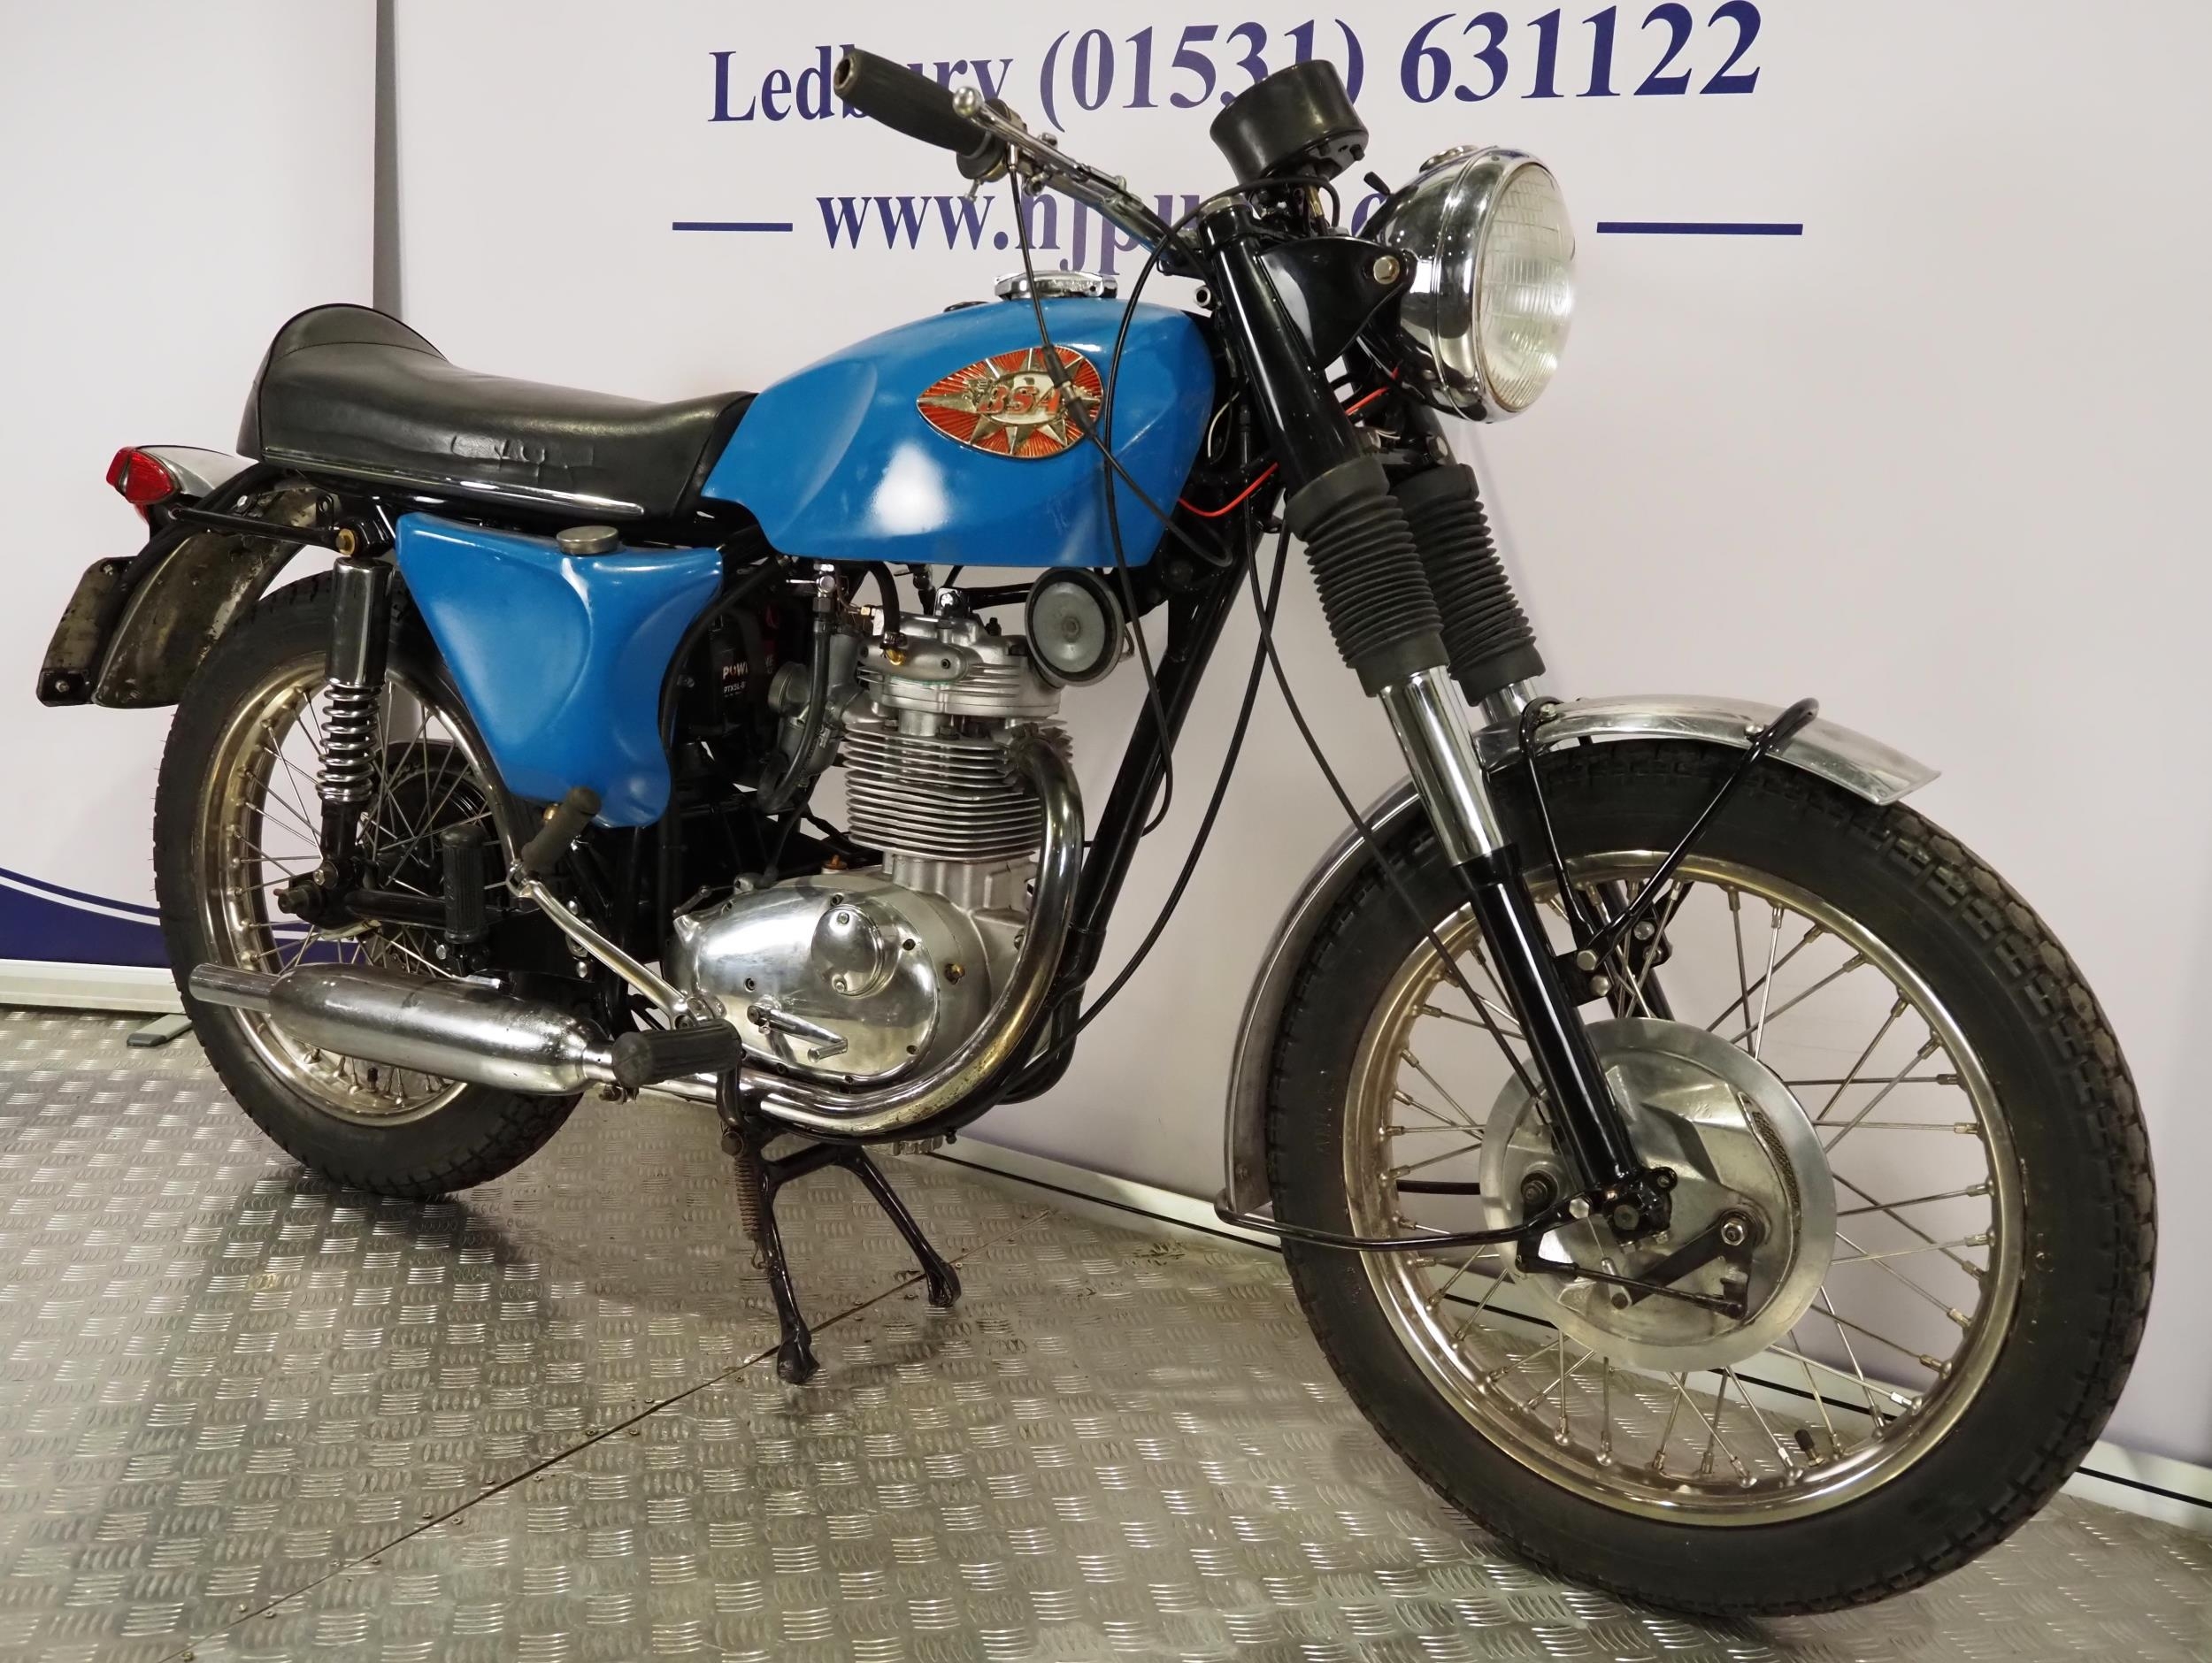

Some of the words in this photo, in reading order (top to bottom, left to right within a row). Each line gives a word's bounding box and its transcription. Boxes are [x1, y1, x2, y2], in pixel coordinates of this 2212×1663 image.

[708, 43, 1013, 122] Ledry
[1400, 0, 1762, 103] 631122
[974, 384, 1060, 416] BSA
